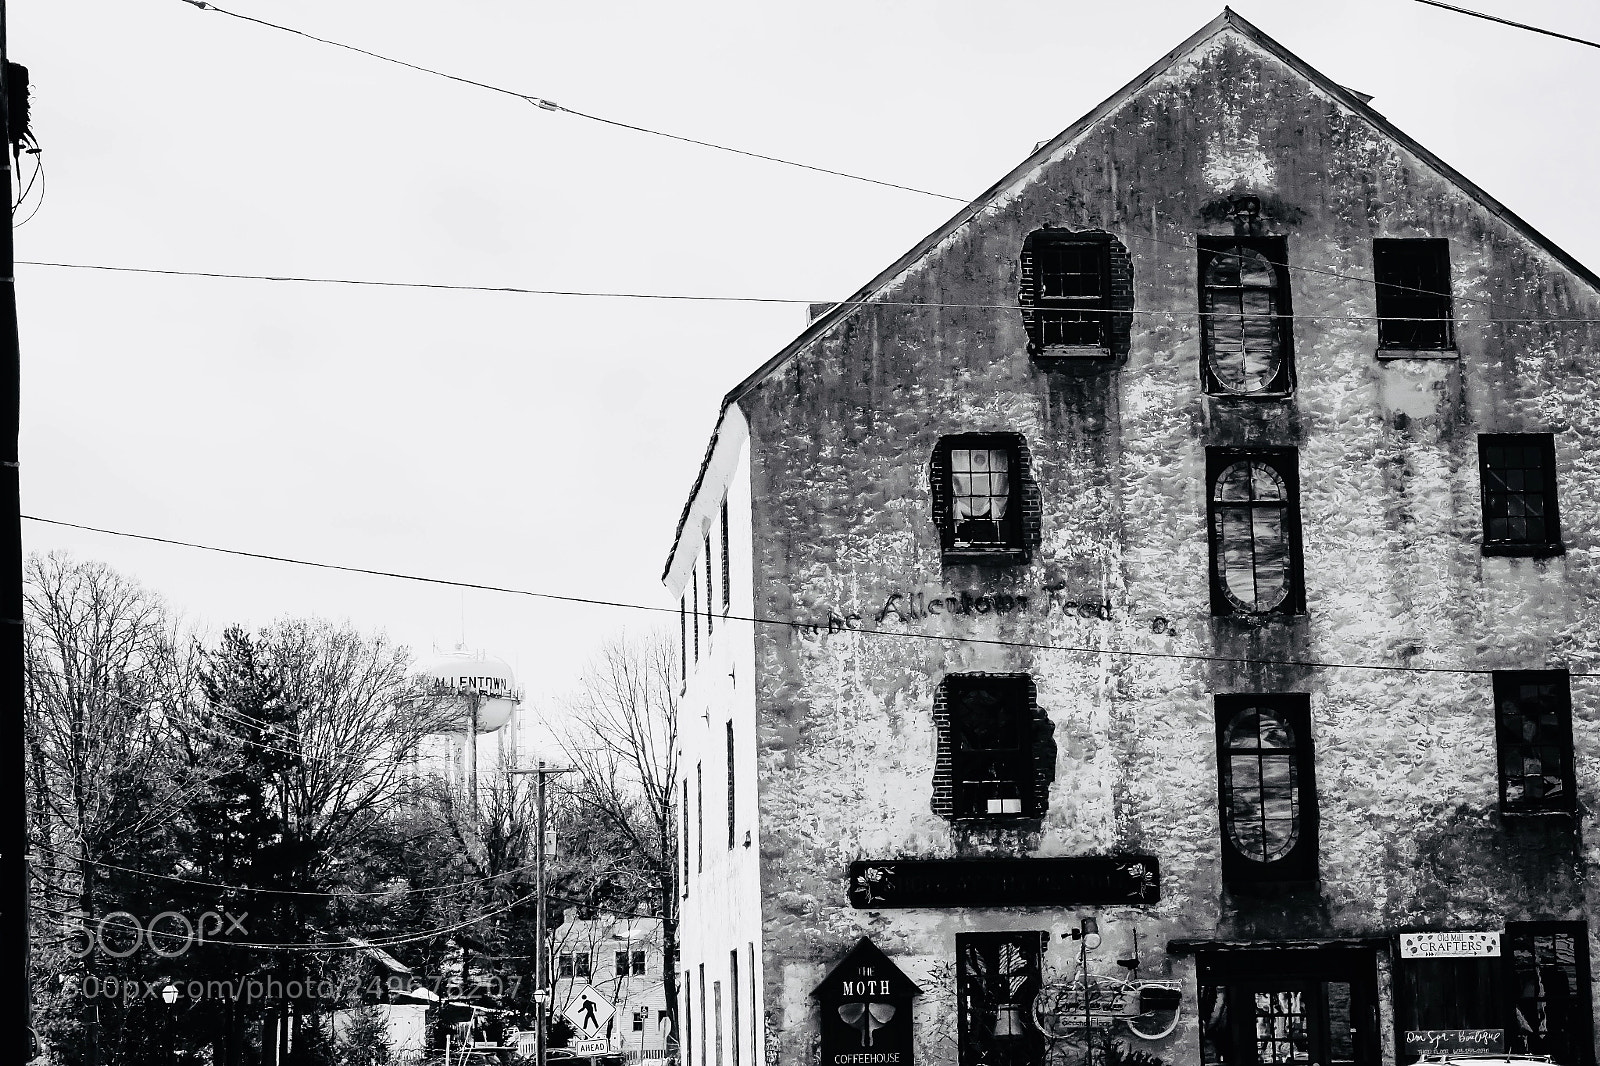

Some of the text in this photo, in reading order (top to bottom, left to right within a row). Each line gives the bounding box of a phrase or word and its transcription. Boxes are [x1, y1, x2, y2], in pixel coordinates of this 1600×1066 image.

[434, 676, 507, 690] ALLENTOWN
[1419, 941, 1482, 952] CRAFTERS
[842, 980, 891, 996] MOTH
[580, 1042, 605, 1053] AHEAD
[834, 1052, 901, 1065] COFFEEHOUSE
